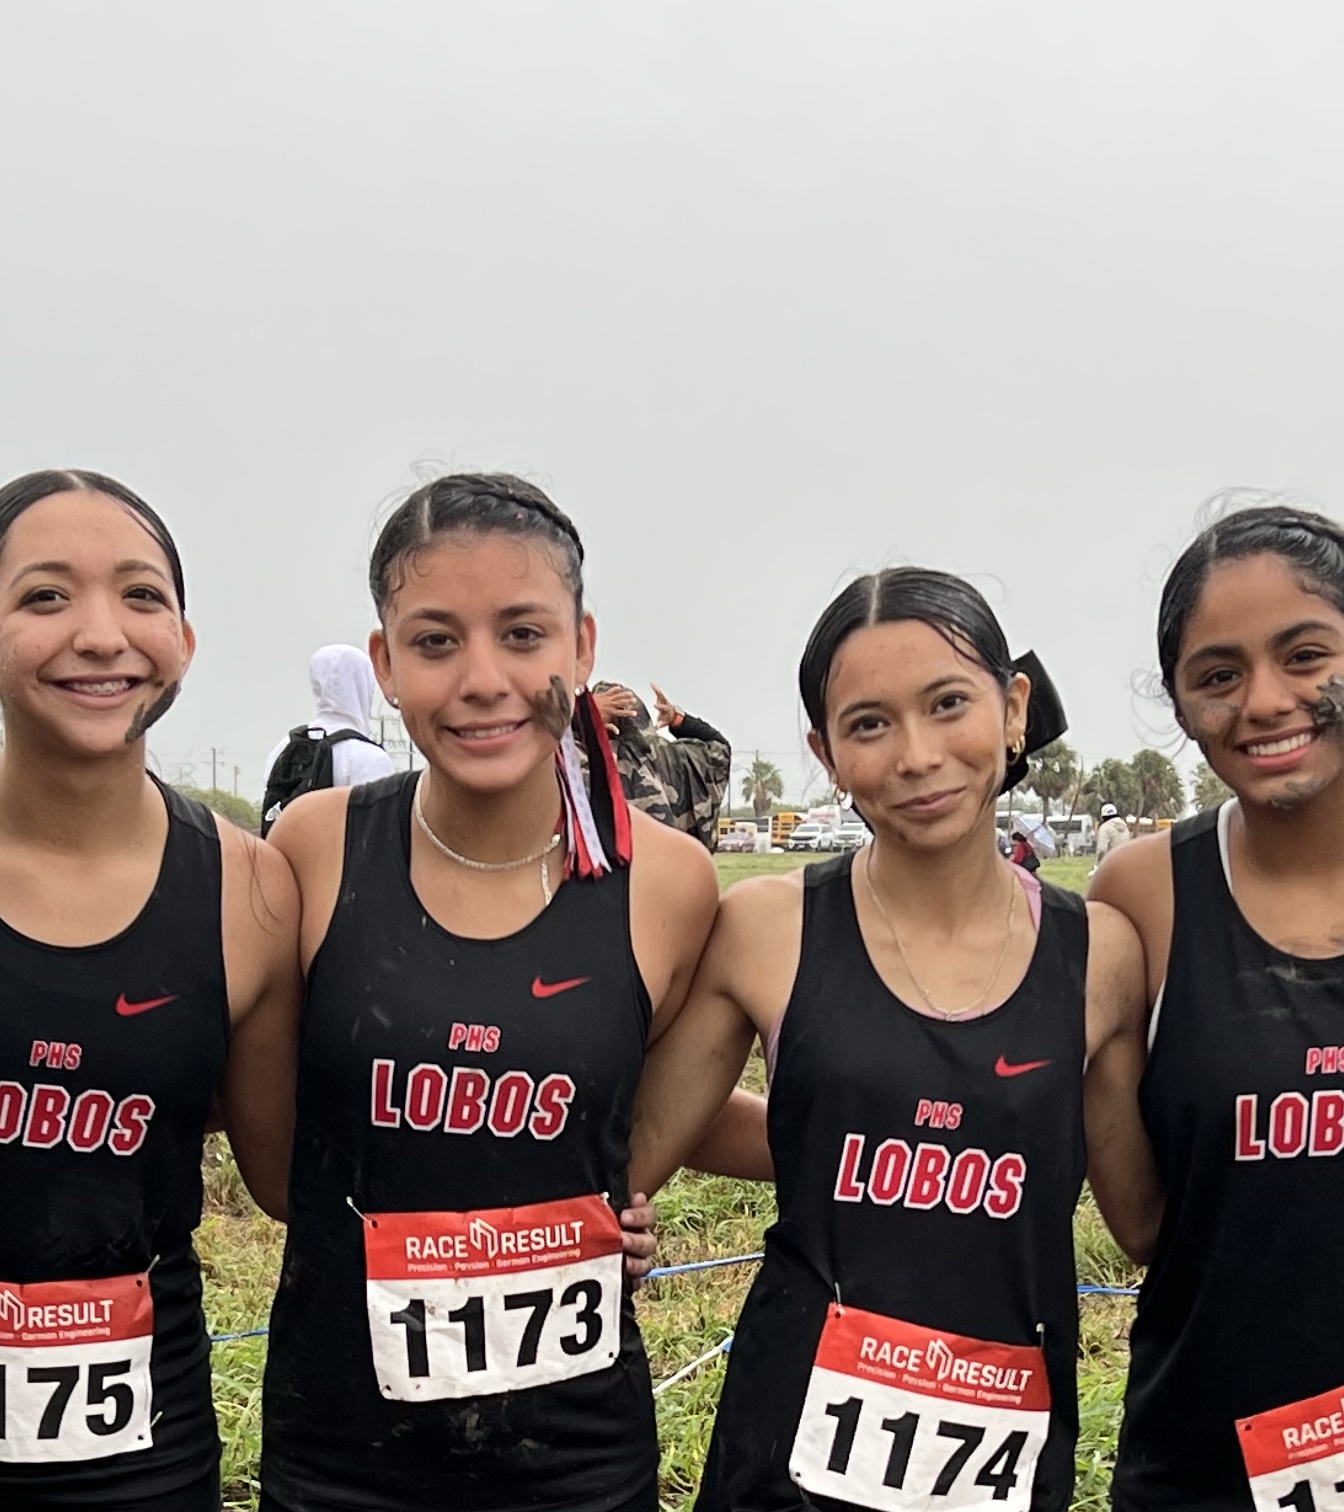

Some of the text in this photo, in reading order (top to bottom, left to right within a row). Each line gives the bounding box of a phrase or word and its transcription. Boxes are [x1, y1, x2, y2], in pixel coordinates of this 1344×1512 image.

[29, 1040, 82, 1070] PHS
[448, 1022, 501, 1052] PHS
[371, 1058, 576, 1141] LOBOS
[914, 1099, 963, 1130] PHS
[833, 1133, 1027, 1219] LOBOS
[406, 1221, 584, 1259] RACE RESULT
[27, 1299, 113, 1328] RESULT
[390, 1279, 603, 1378] 1173
[860, 1336, 1034, 1392] RACE RESULT
[825, 1396, 1030, 1501] 1174
[1282, 1412, 1344, 1450] RACE
